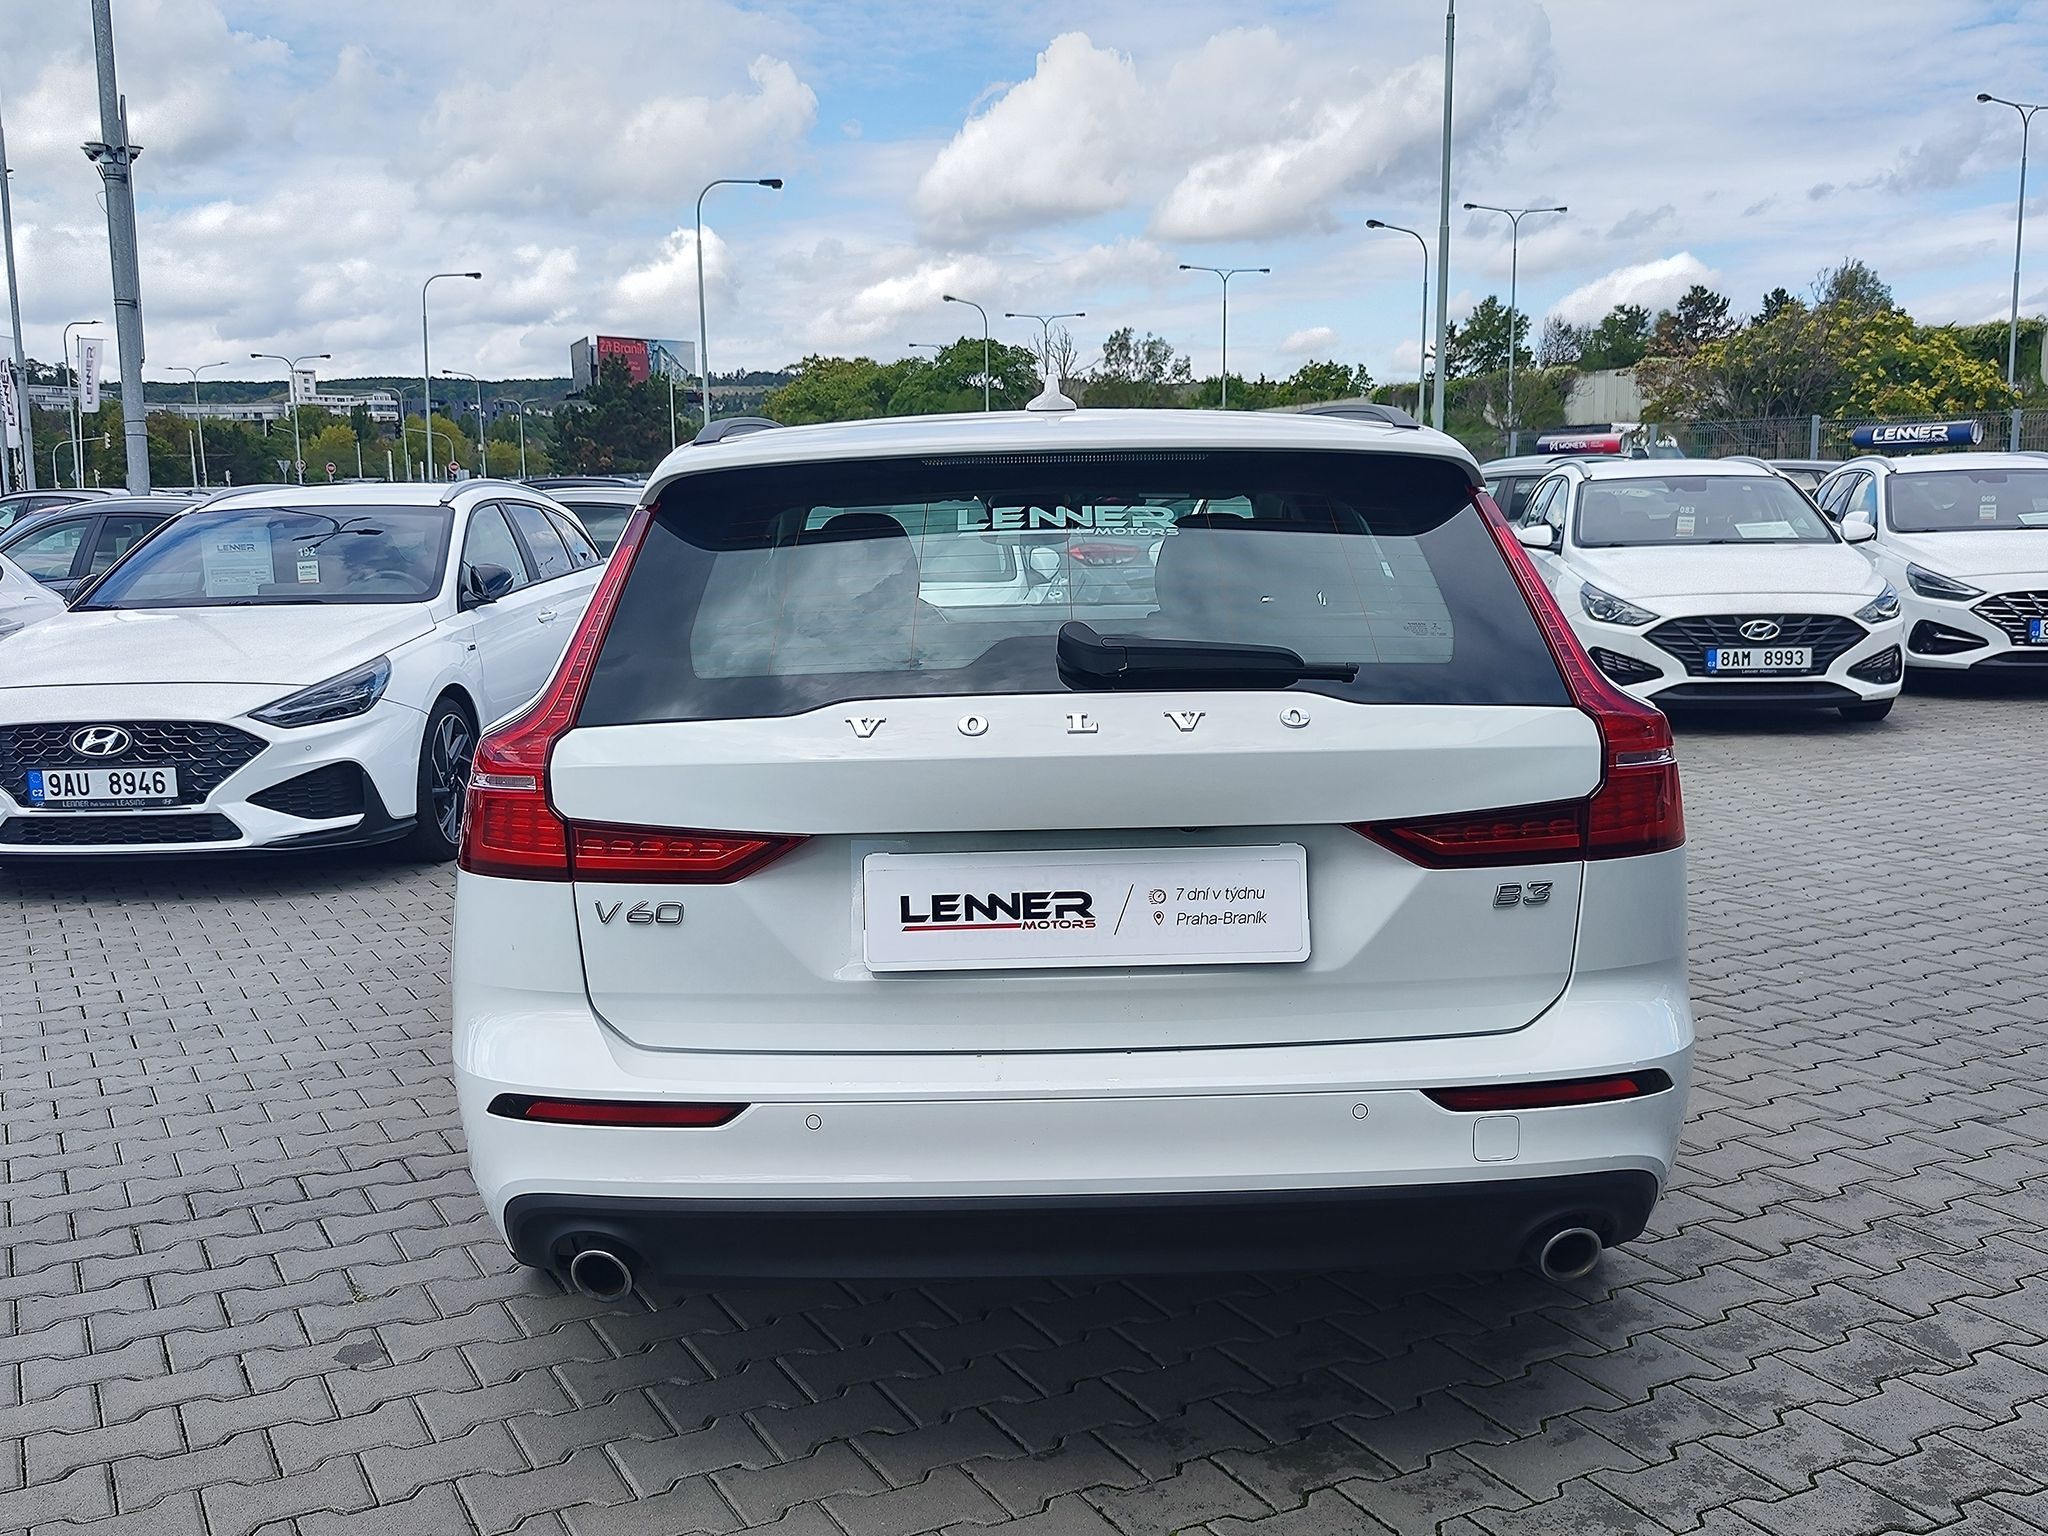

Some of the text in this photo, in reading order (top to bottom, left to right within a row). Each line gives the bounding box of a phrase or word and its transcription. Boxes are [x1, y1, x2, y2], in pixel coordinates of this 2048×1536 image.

[86, 345, 96, 405] LENNER
[1872, 425, 1949, 441] LENNER
[1559, 441, 1587, 450] MONETA
[957, 505, 1178, 531] LENNER
[1094, 527, 1180, 536] MOTORS
[216, 543, 256, 552] LENNER
[298, 547, 316, 557] 192
[1721, 650, 1804, 666] 8AM 8993
[845, 707, 1312, 739] VOLVO
[48, 771, 166, 797] 9AU 8946
[32, 789, 43, 797] CZ
[1176, 886, 1266, 903] 7 dní v týdnu
[1493, 881, 1553, 908] B3
[900, 890, 1096, 923] LENNER
[1022, 919, 1097, 931] MOTORS
[1176, 910, 1268, 926] Praha-Braník
